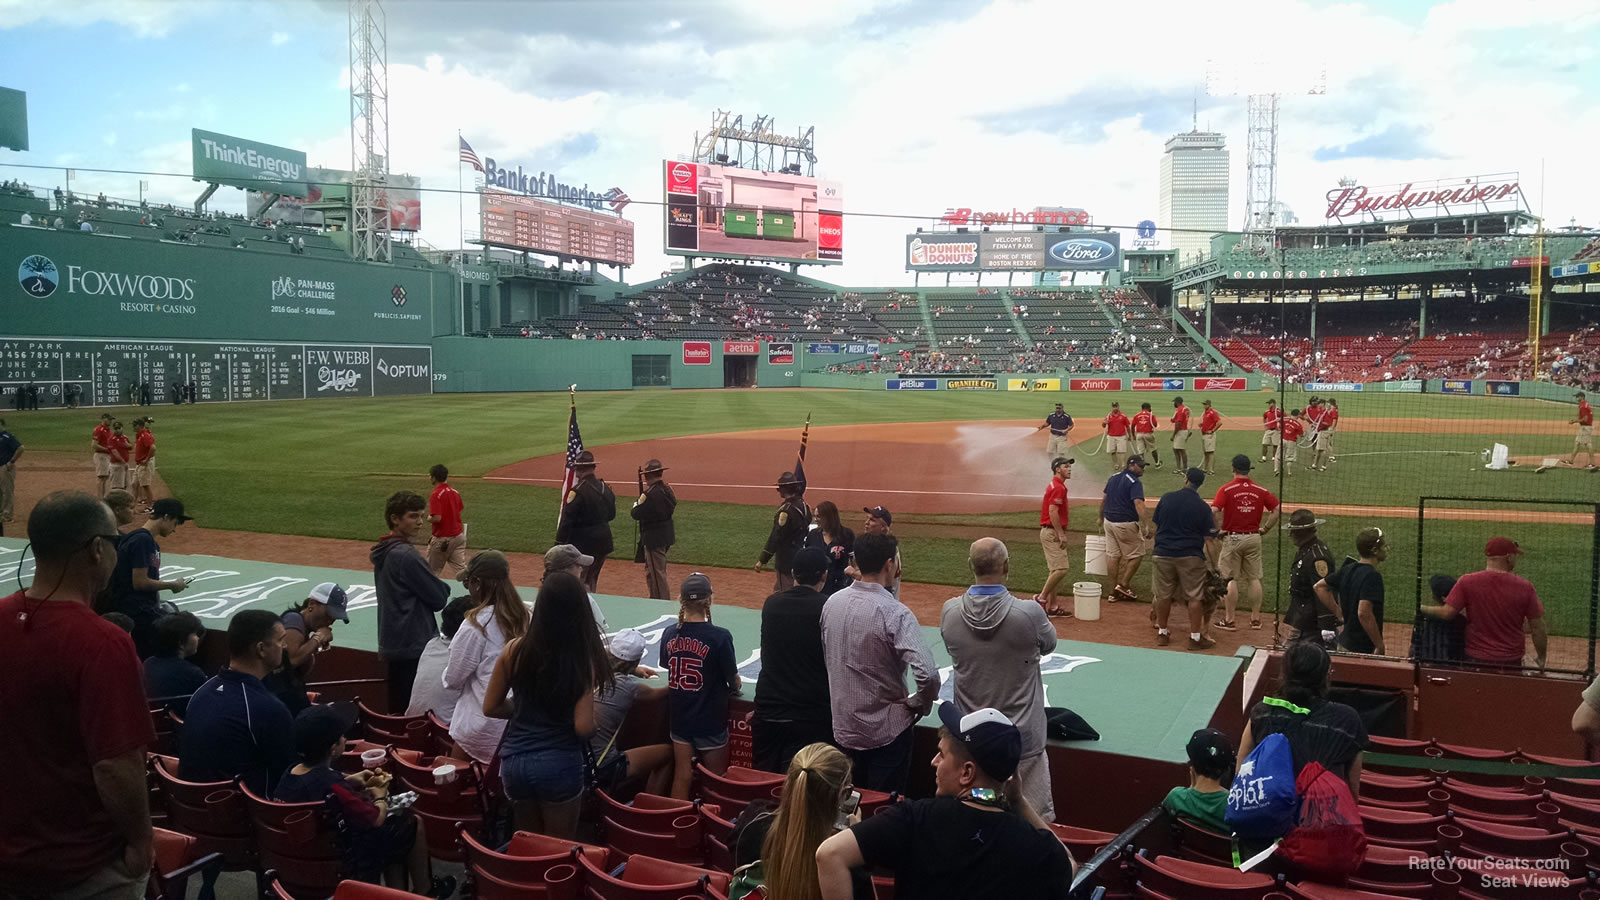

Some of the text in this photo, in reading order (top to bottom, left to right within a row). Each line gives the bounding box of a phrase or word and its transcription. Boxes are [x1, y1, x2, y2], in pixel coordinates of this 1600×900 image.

[201, 138, 299, 180] ThinkEnergy
[485, 157, 603, 210] Bank of America
[1325, 178, 1518, 219] Budweiser
[973, 208, 1090, 225] new balance
[928, 245, 976, 253] DUNKIN'
[1062, 244, 1102, 260] Ford
[928, 254, 973, 263] DONUTS
[461, 270, 490, 280] ABIOMED
[66, 265, 194, 300] FOXWOODS
[298, 279, 335, 290] PAN-MASS
[298, 290, 335, 300] CHALLENGE
[120, 302, 196, 314] RESORT CASINO
[730, 344, 754, 352] aetna
[307, 350, 370, 364] F.W. WEBB
[389, 365, 428, 378] OPTUM
[899, 380, 925, 389] jetBlue
[980, 380, 997, 388] CITY
[1081, 381, 1109, 390] xfinity
[667, 637, 710, 660] PEDROIA
[668, 657, 703, 691] 15
